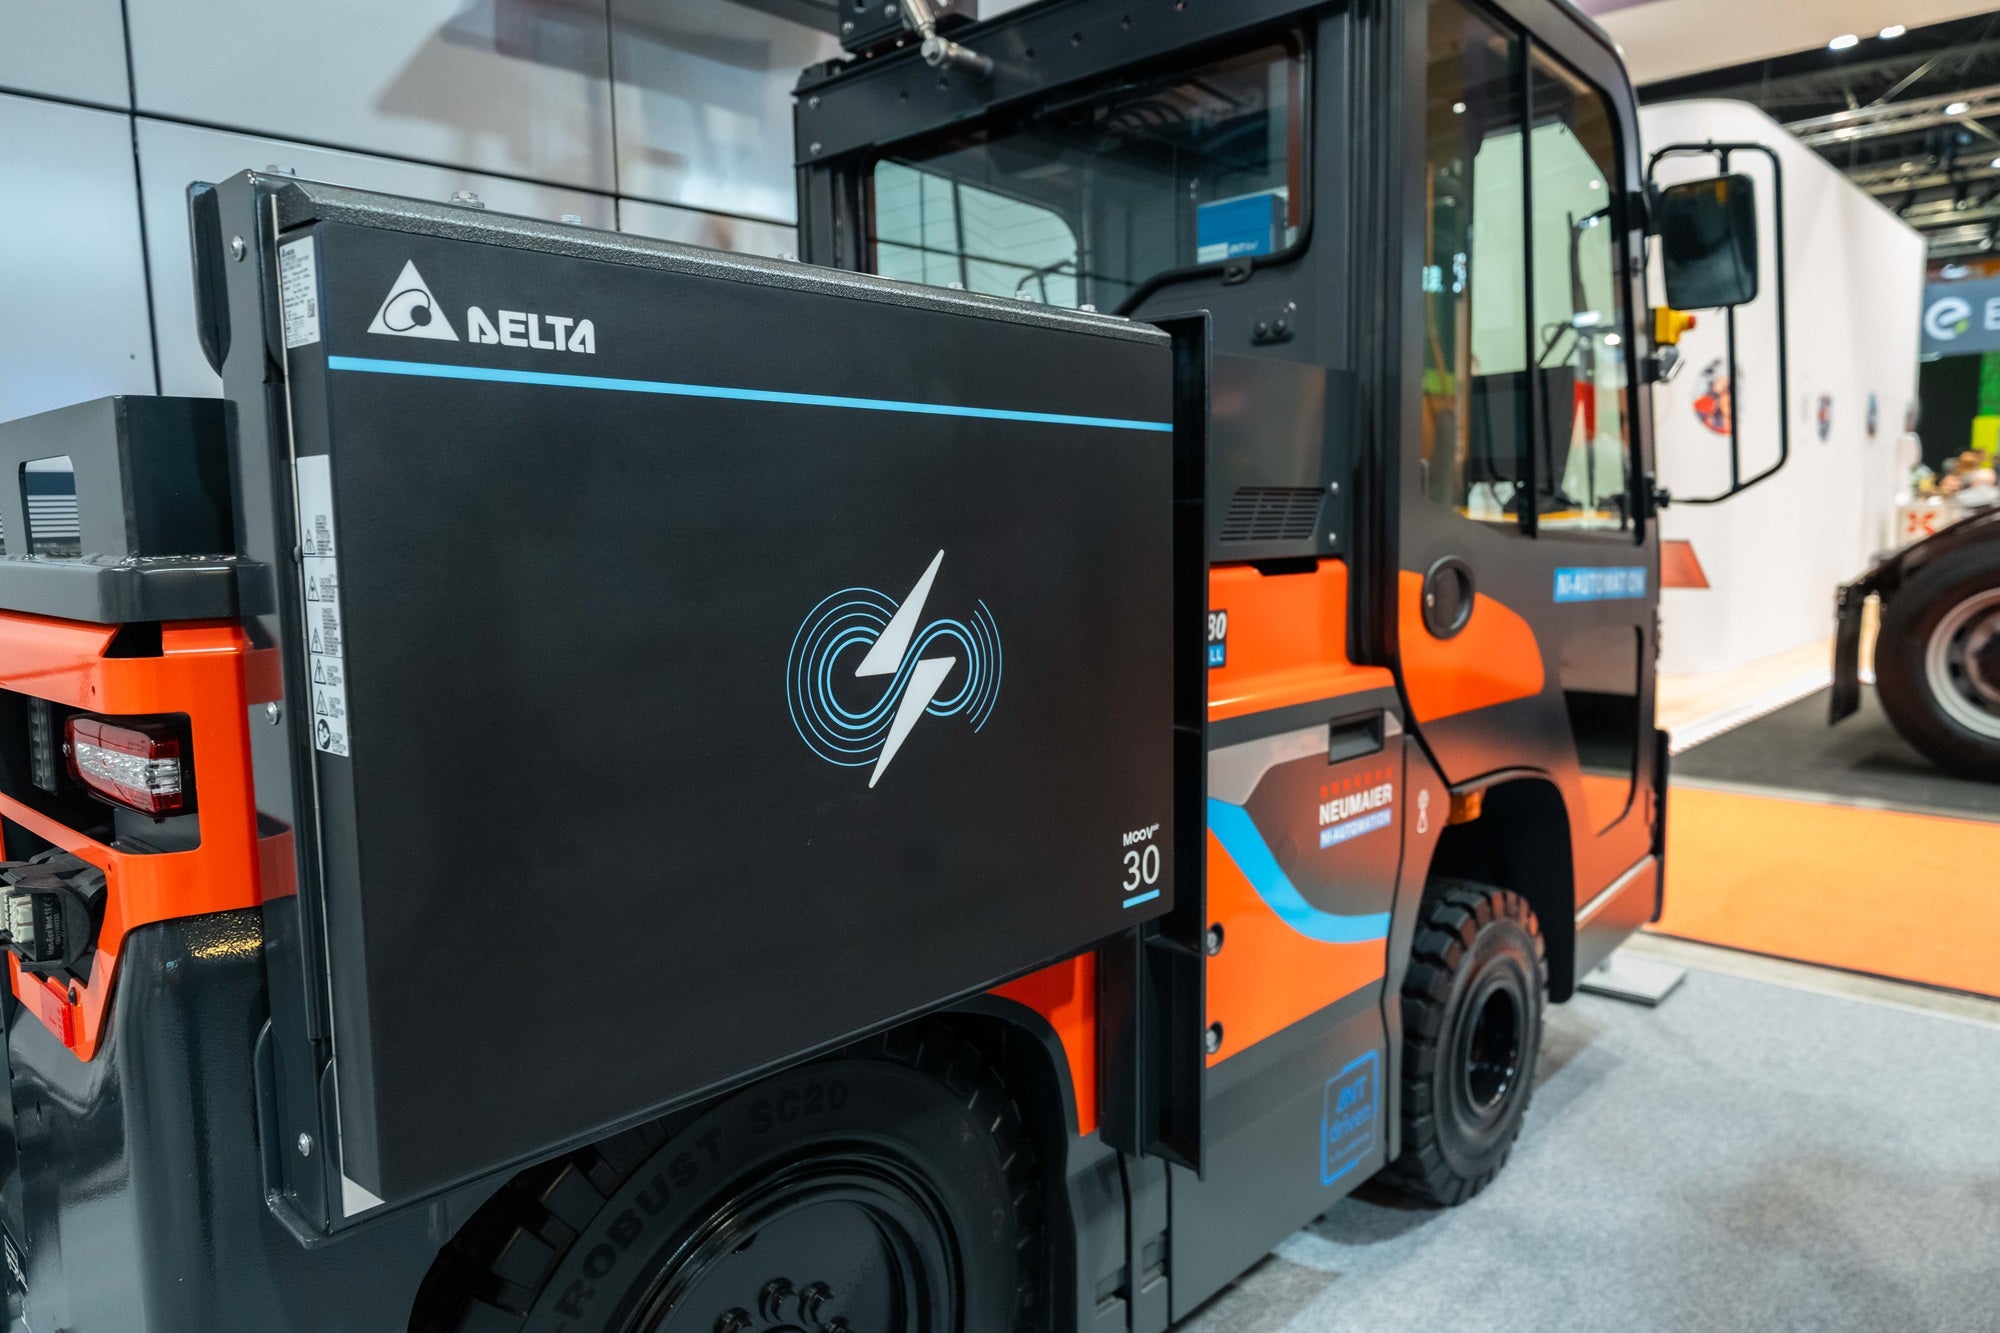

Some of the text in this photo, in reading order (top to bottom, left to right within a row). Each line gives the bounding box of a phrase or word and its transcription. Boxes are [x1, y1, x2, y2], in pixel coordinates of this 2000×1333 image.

[466, 305, 596, 354] DELTA
[1319, 783, 1393, 826] NEUMAIER
[1122, 844, 1160, 891] 30
[554, 1079, 848, 1321] ROBUST SC20
